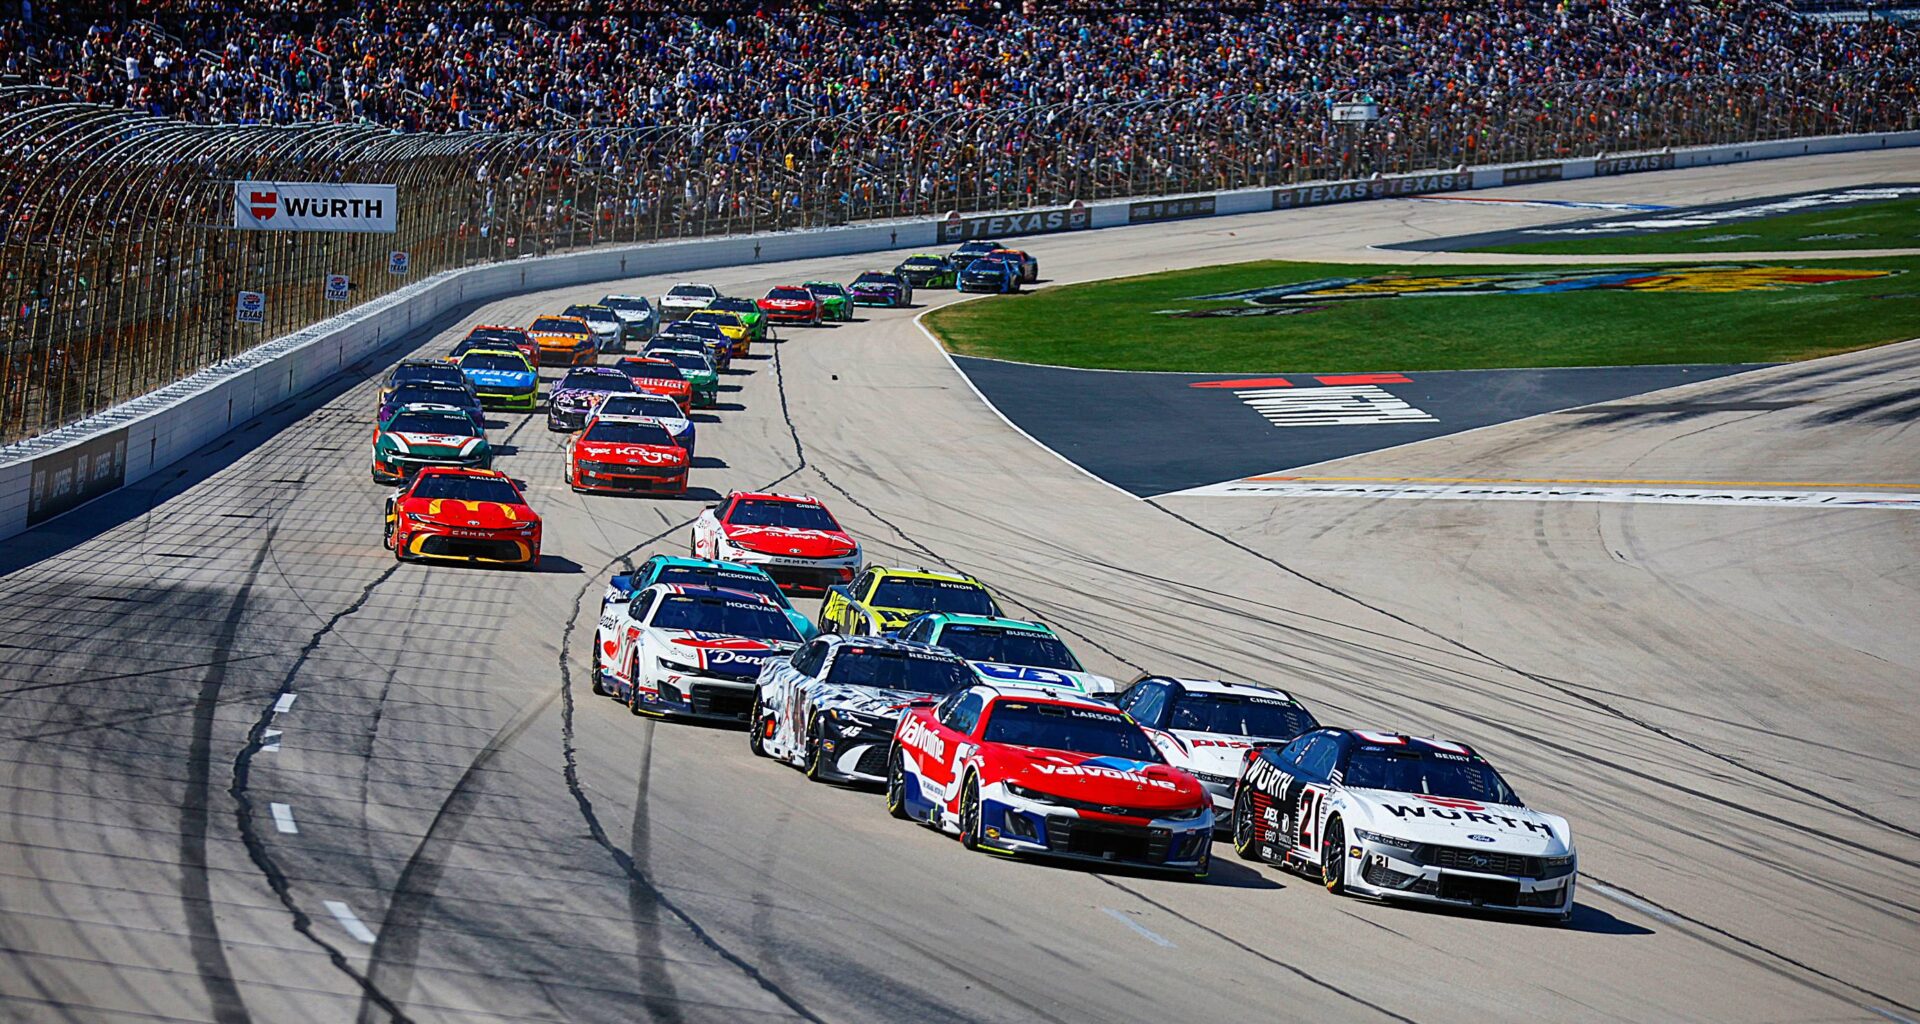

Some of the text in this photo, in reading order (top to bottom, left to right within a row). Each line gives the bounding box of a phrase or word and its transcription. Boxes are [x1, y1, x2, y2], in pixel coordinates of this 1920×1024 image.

[1609, 155, 1660, 171] TEXAS
[1385, 175, 1453, 193] TEXAS
[1296, 182, 1368, 204] TEXAS
[284, 198, 382, 219] WÜRTH
[968, 211, 1063, 237] TEXAS
[327, 289, 347, 298] TEXAS
[239, 309, 262, 319] TEXAS
[615, 446, 681, 463] Kroger
[451, 530, 496, 538] CAMRY
[775, 558, 818, 566] CAMRY
[717, 571, 769, 582] MCDOWELL
[940, 582, 973, 591] BYRON
[726, 600, 780, 613] HOCEVAR
[1006, 629, 1053, 640] BUESCHE
[908, 652, 957, 664] REDDICK
[667, 675, 682, 684] 77
[1249, 697, 1291, 707] CINDRIC
[1071, 710, 1122, 723] LARSON
[841, 725, 863, 738] 45
[898, 711, 945, 765] Valvoline
[1434, 747, 1470, 763] BERRY
[942, 742, 972, 801] 5
[1030, 763, 1178, 791] Valvoline
[1245, 756, 1295, 802] WÜRTH
[1263, 806, 1279, 822] DEX
[1299, 788, 1325, 853] 21
[1382, 803, 1554, 839] WÜRTH
[1375, 854, 1390, 869] 21
